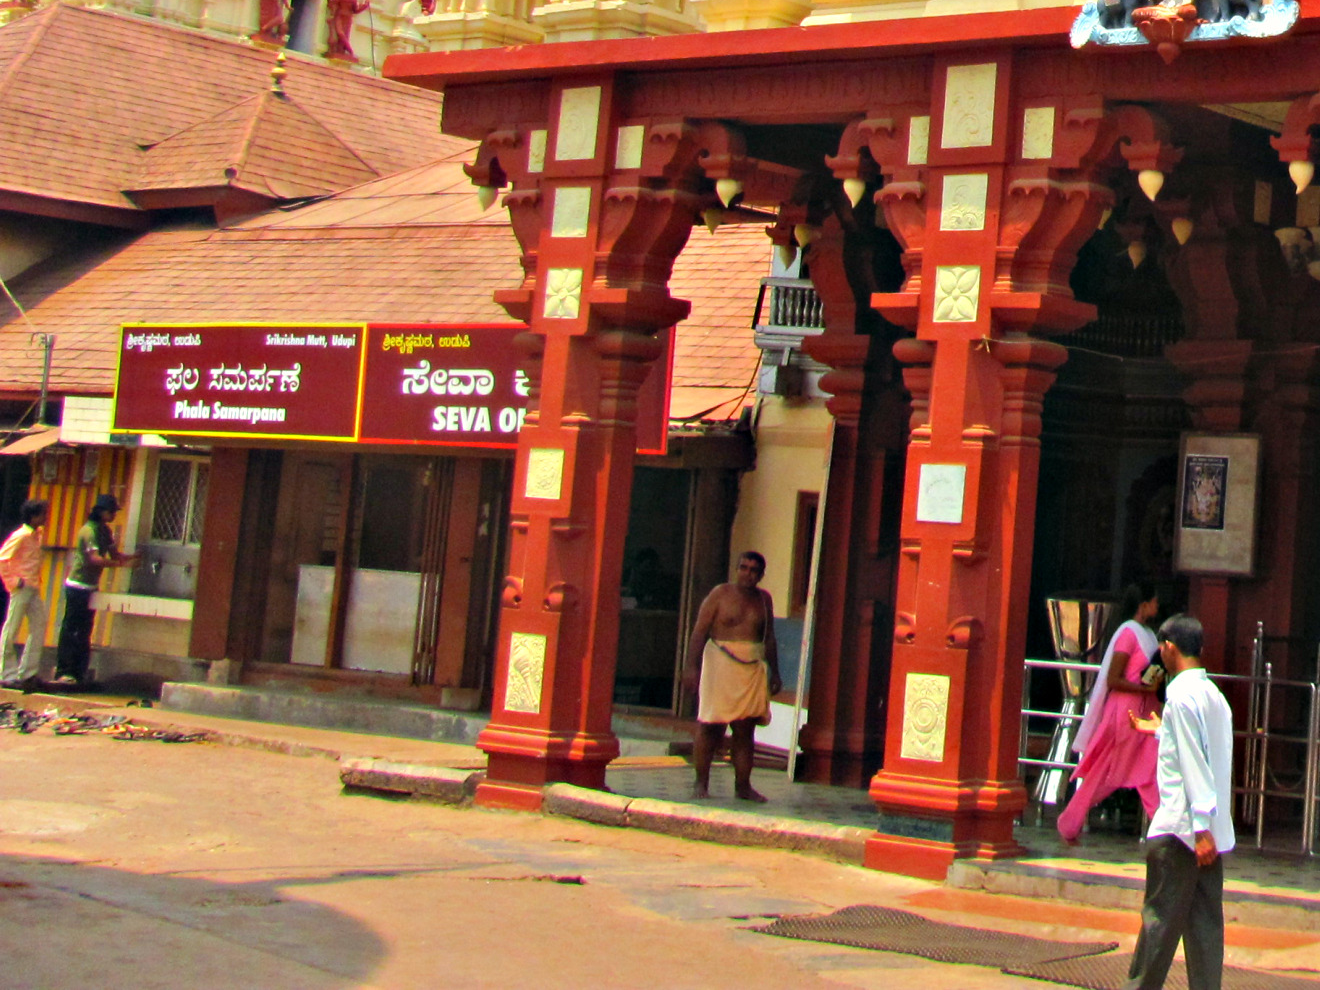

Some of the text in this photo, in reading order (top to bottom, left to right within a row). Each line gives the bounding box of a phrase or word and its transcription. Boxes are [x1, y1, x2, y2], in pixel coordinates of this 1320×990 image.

[174, 332, 202, 346] ಉಡುಪಿ
[265, 333, 357, 348] Srikrishna Mutt, Udupi
[438, 333, 471, 348] ಉಡುಪಿ
[165, 362, 302, 395] ಫಲ ಸಮರ್ಪಣೆ
[402, 360, 495, 396] ಸೇವಾ
[174, 399, 286, 424] Phala Samarpana
[432, 405, 492, 433] SEVA
